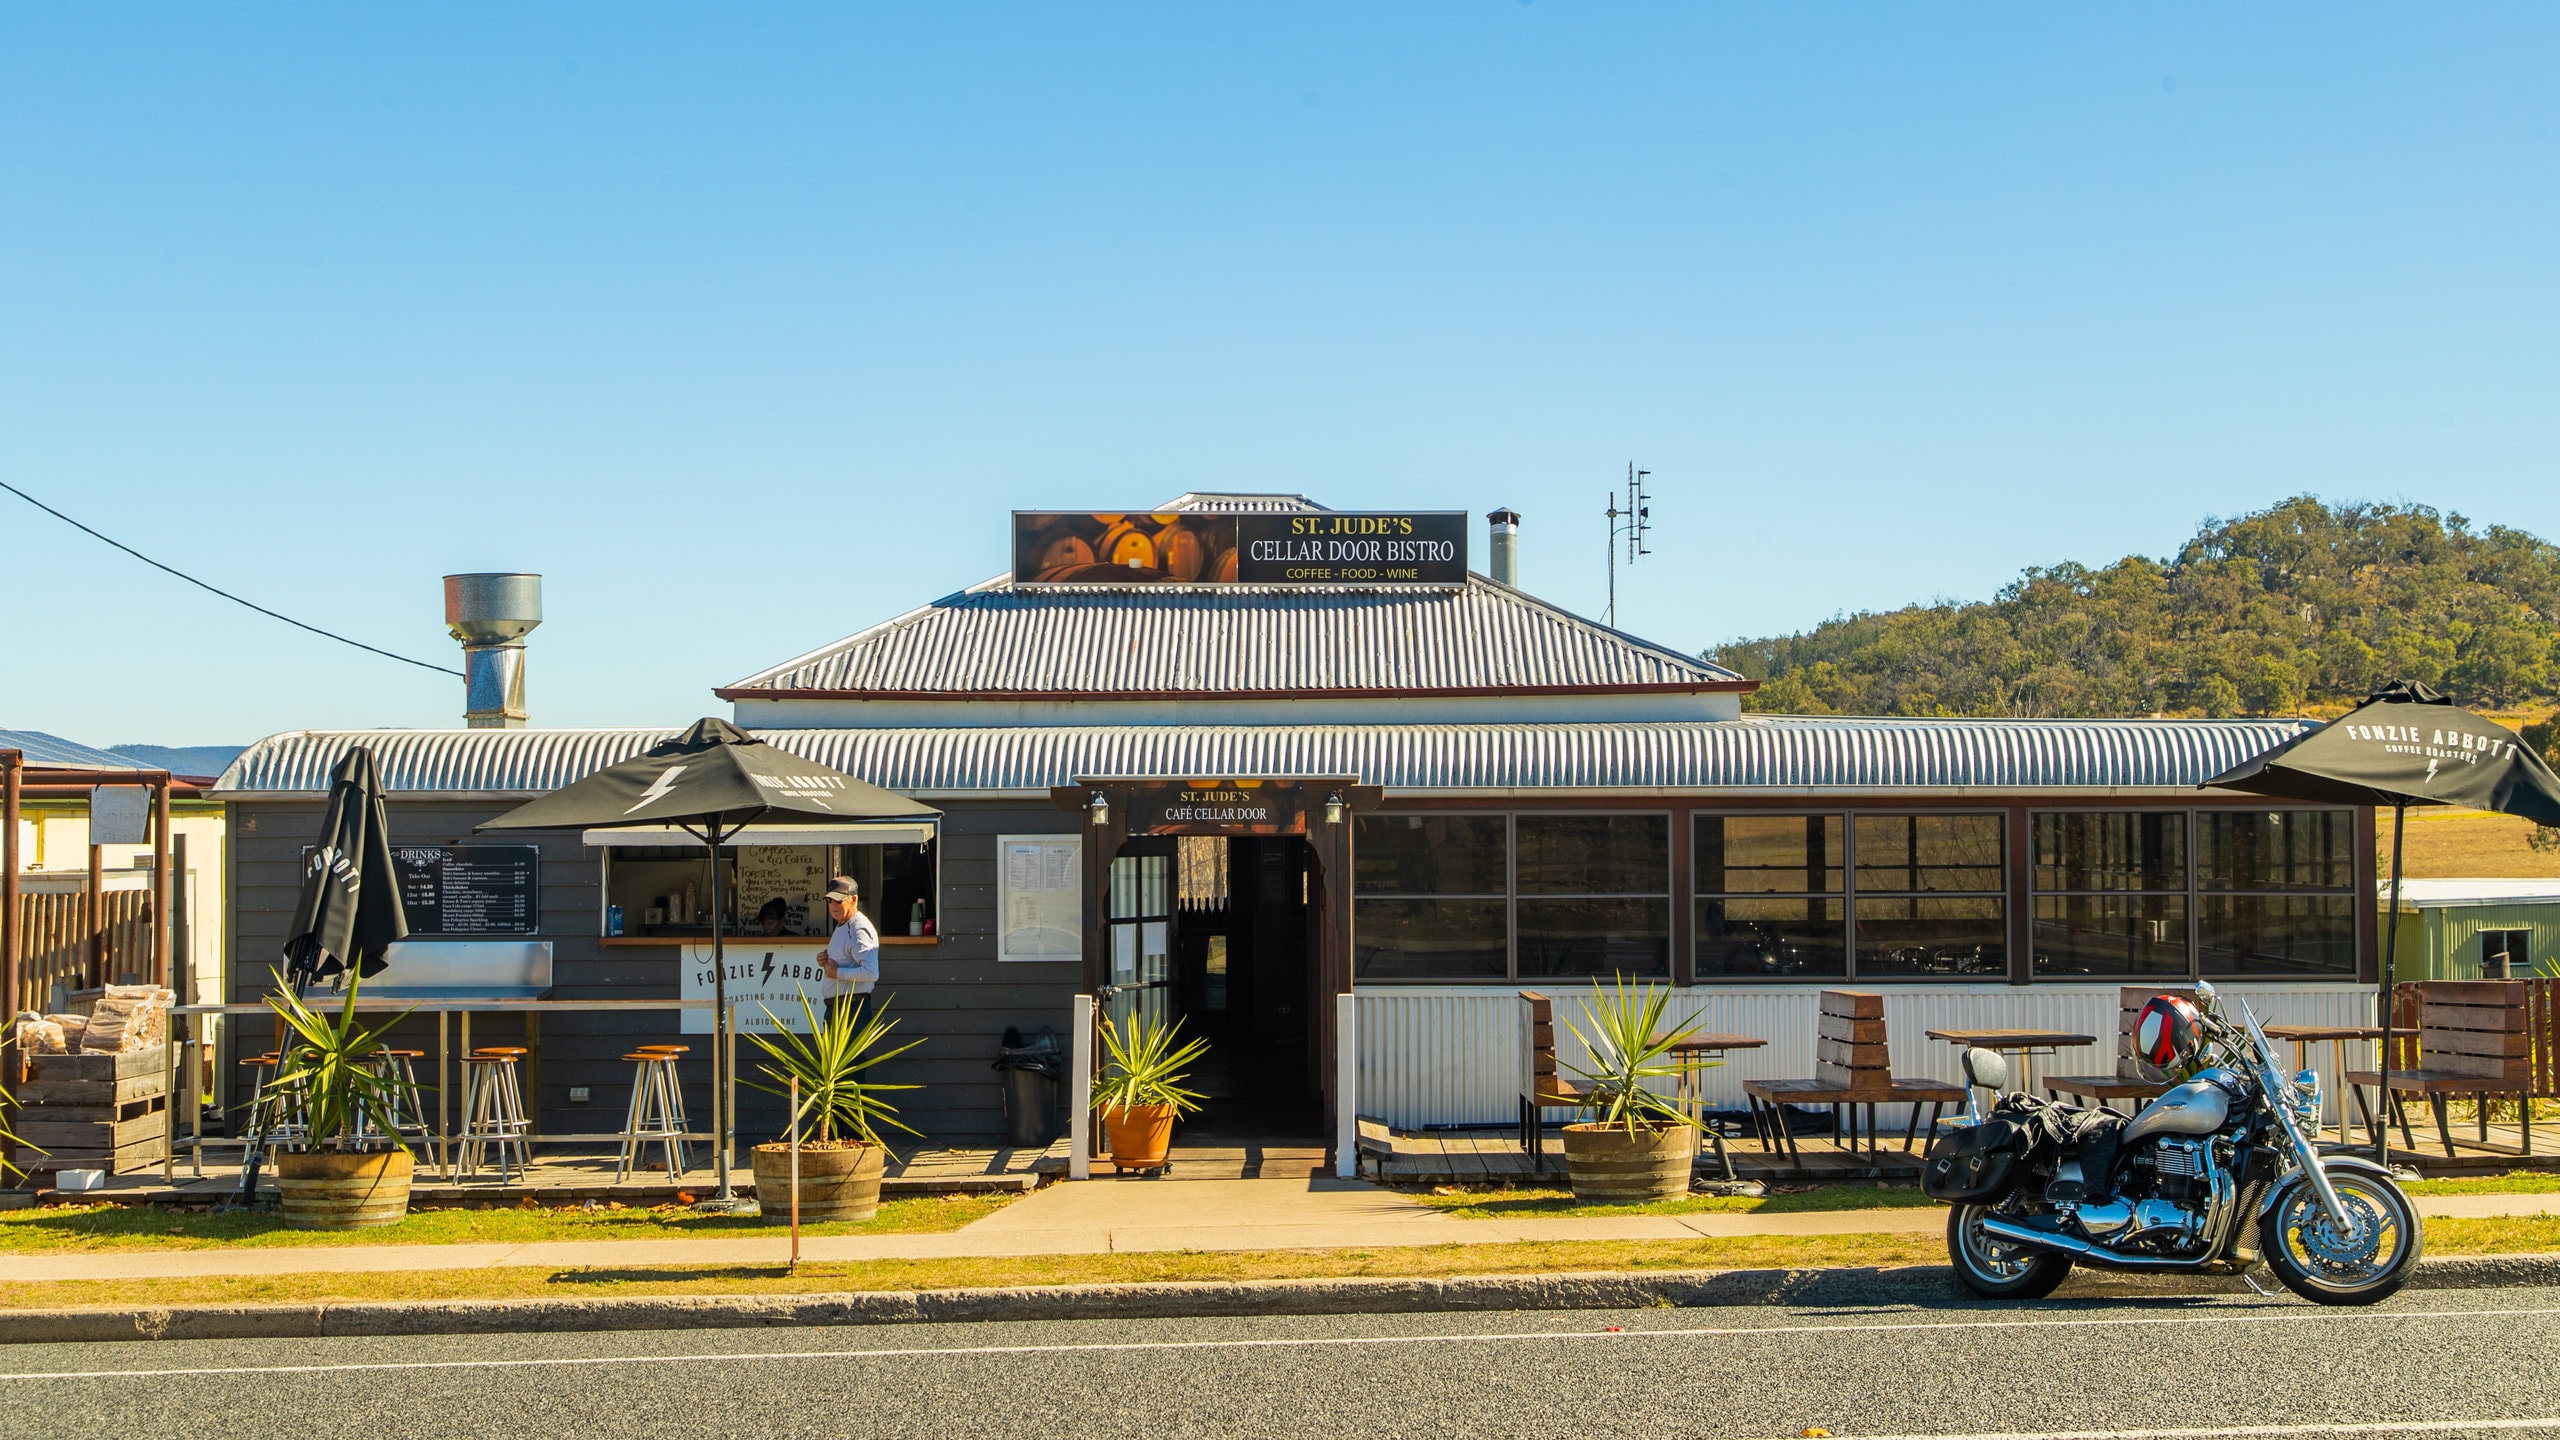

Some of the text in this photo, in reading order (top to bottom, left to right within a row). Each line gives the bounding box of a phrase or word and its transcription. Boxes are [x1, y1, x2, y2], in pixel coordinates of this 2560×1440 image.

[1291, 517, 1413, 535] ST. JUDE'S
[1250, 540, 1454, 562] CELLAR DOOR BISTRO
[1286, 568, 1332, 579] COFFEE
[1341, 568, 1377, 579] FOOD
[1386, 568, 1418, 579] WINE
[2345, 724, 2518, 761] FONZIE ABBOTT
[2385, 744, 2478, 765] COFFEE ROASTERS
[1180, 791, 1250, 802] ST. JUDE'S
[1165, 804, 1267, 820] CAFÉ CELLAR DOOR
[401, 850, 441, 859] DRINKS
[697, 964, 824, 986] FOZIE ABBO
[724, 993, 818, 1005] ASTING & BREWNG
